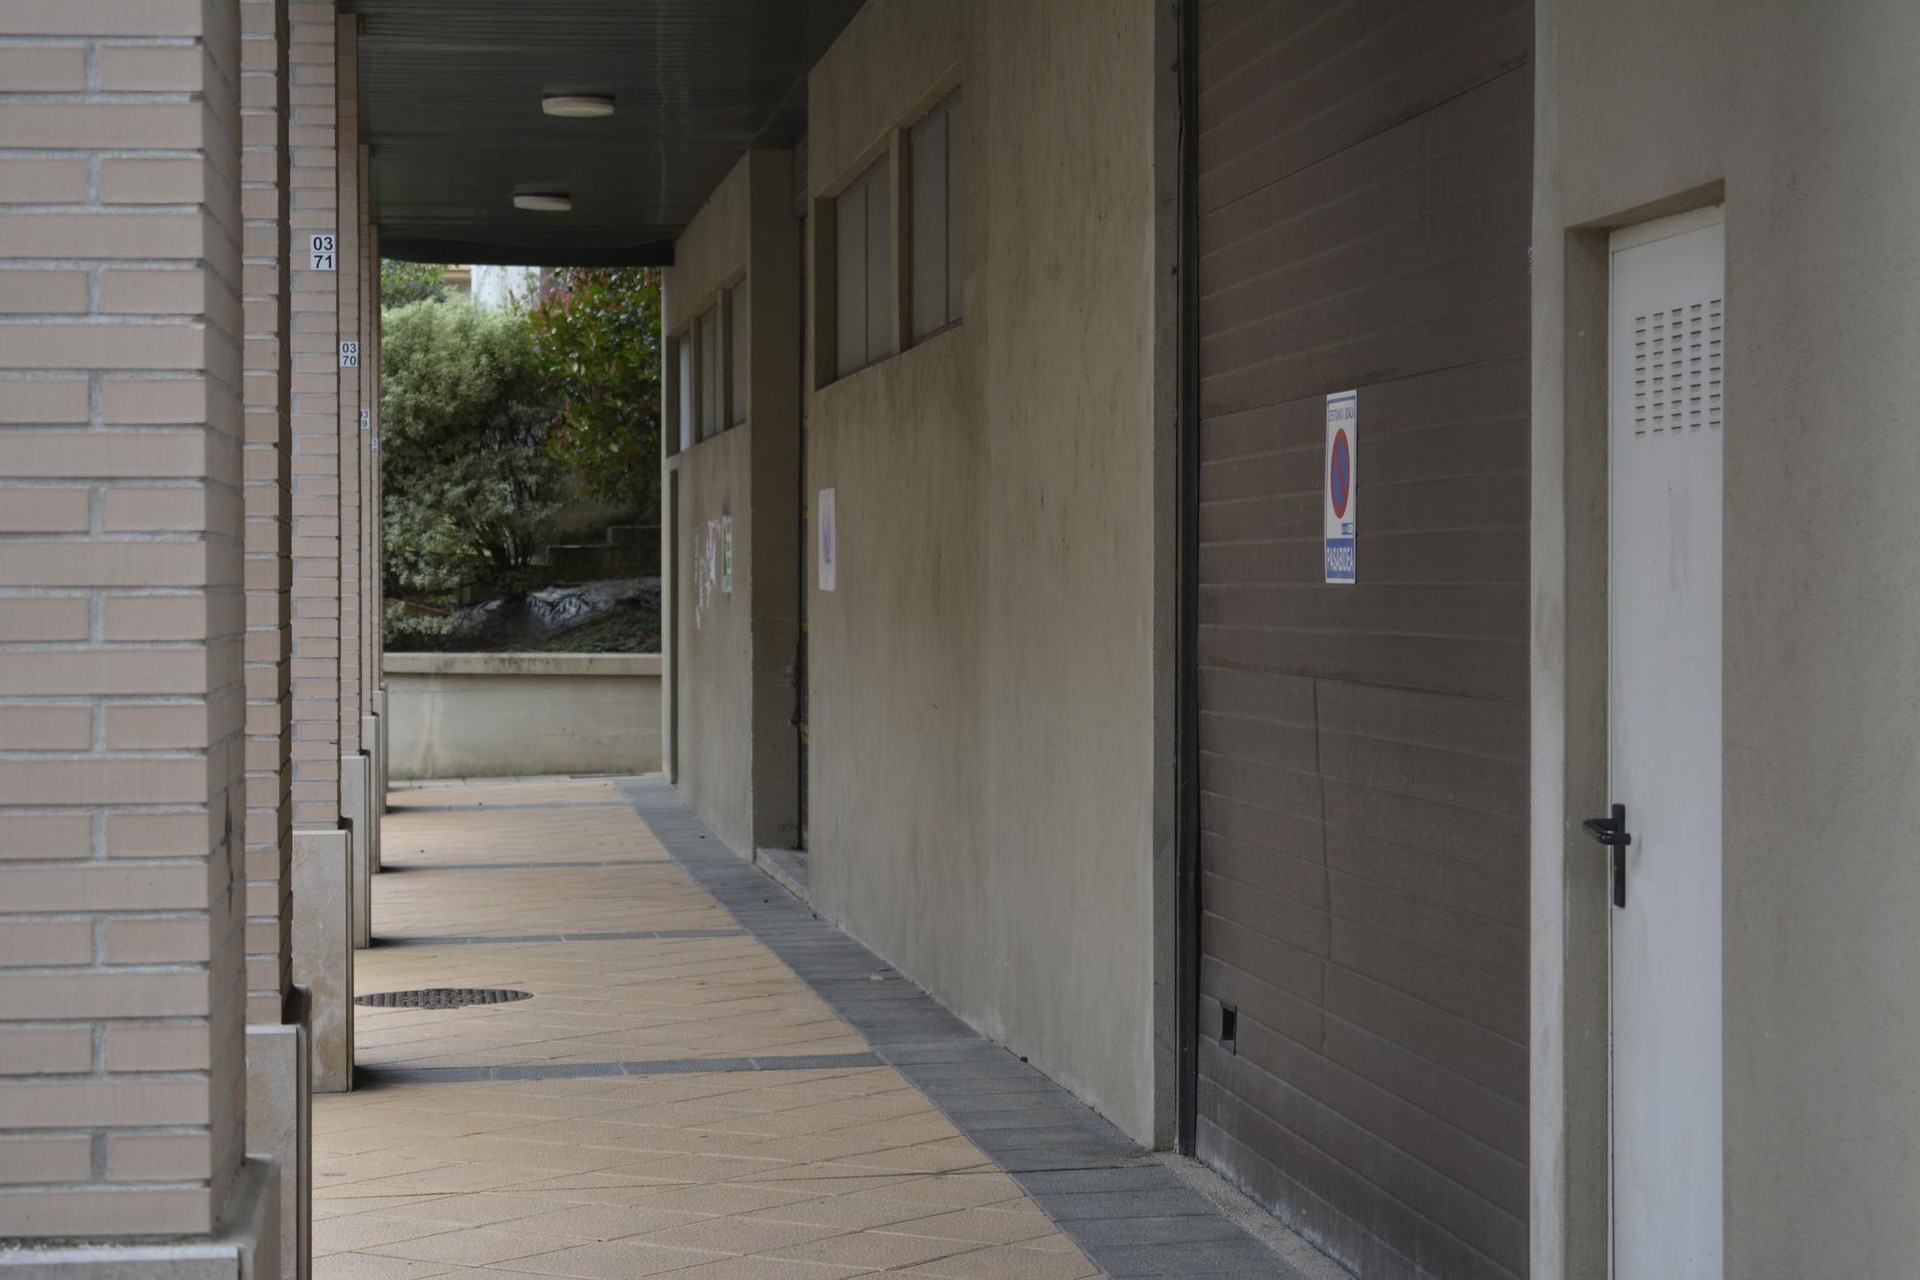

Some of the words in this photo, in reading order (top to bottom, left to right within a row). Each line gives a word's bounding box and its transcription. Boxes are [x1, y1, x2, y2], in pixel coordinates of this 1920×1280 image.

[313, 236, 333, 251] 03
[313, 254, 332, 269] 71
[342, 342, 357, 354] 03
[342, 355, 357, 366] 70
